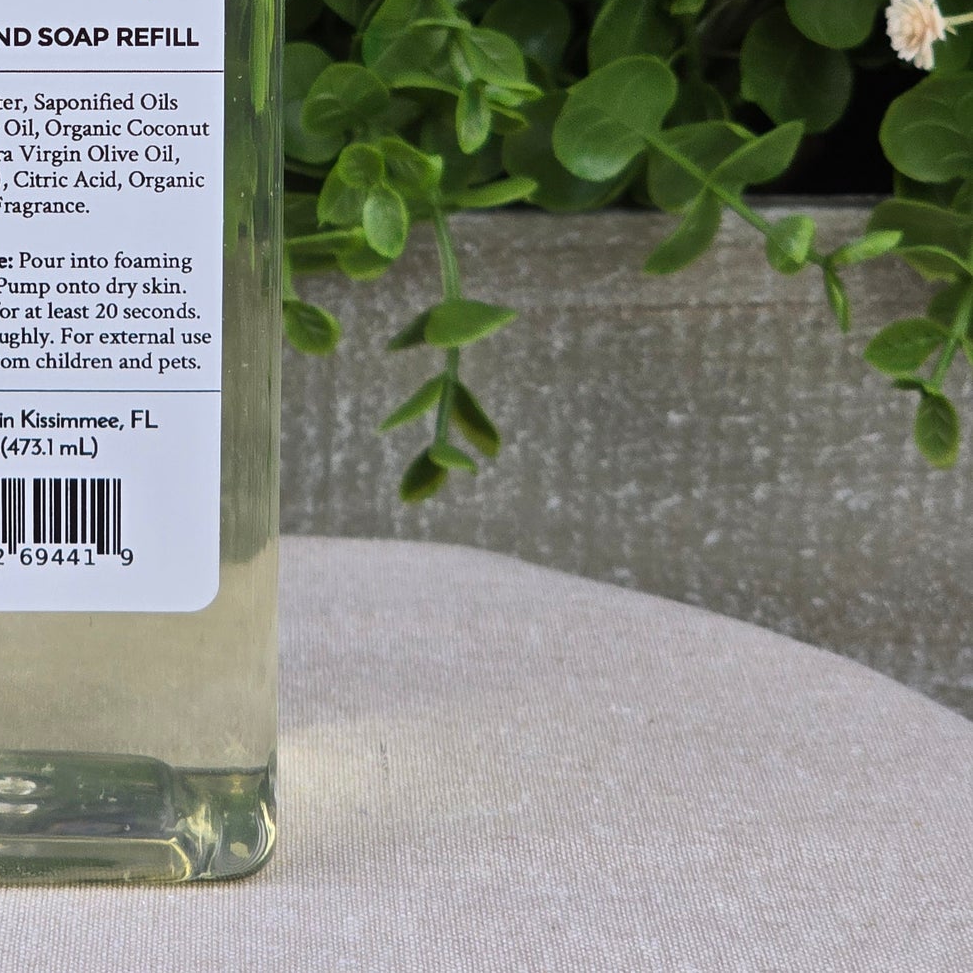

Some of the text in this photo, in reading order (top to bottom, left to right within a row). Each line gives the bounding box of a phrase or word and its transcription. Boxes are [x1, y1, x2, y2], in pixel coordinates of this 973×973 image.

[37, 26, 110, 47] SOAP
[116, 27, 200, 47] REFILL
[33, 92, 135, 115] Saponified
[140, 92, 179, 111] Oils
[3, 118, 40, 140] Oil,
[44, 118, 122, 141] Organic
[126, 118, 210, 137] Coconut
[18, 144, 82, 166] Virgin
[87, 144, 140, 163] Olive
[144, 144, 180, 166] Oil,
[13, 170, 69, 189] Citric
[72, 169, 123, 192] Acid,
[128, 170, 205, 192] Organic
[18, 251, 66, 269] Pour
[69, 252, 109, 269] into
[113, 250, 193, 274] foaming
[55, 279, 101, 295] onto
[105, 276, 139, 299] dry
[142, 276, 187, 295] skin.
[24, 305, 43, 320] at
[46, 301, 90, 320] least
[94, 302, 118, 319] 20
[122, 301, 201, 320] seconds.
[60, 326, 95, 345] For
[98, 326, 176, 345] external
[180, 332, 212, 345] use
[35, 351, 113, 370] children
[118, 351, 153, 370] and
[157, 355, 201, 375] pets.
[20, 408, 125, 432] Kissimmee,
[130, 409, 159, 429] FL
[0, 435, 53, 460] (473.1
[59, 435, 99, 460] mL)
[20, 549, 96, 566] 69441
